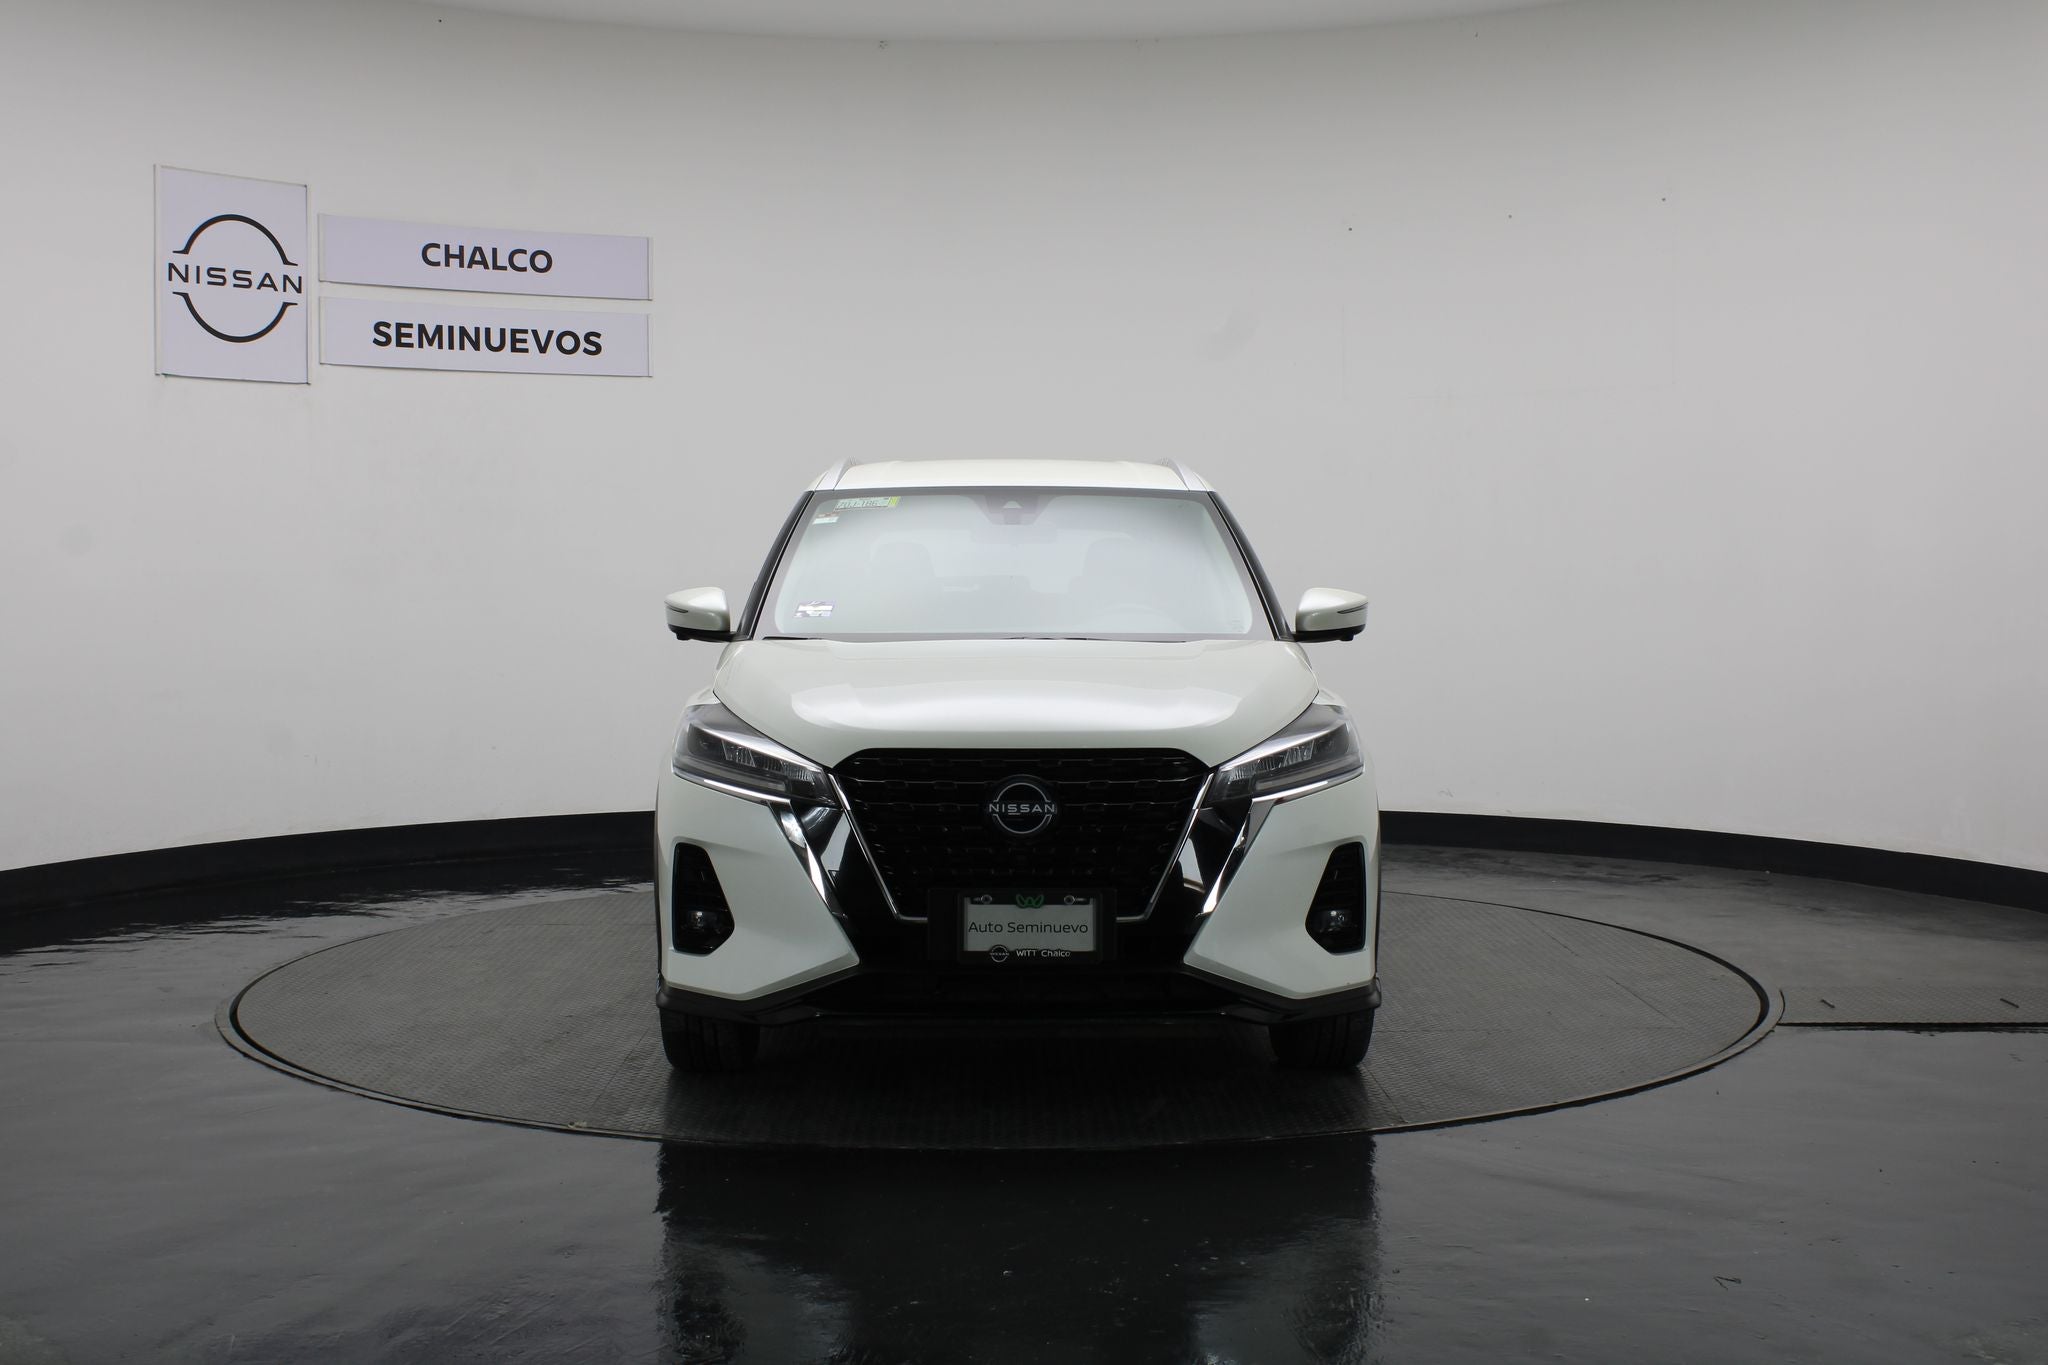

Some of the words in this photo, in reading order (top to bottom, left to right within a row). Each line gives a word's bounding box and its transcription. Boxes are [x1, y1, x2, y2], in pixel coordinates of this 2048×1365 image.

[421, 243, 553, 273] CHALCO
[168, 262, 302, 294] NISSAN
[372, 320, 602, 356] SEMINUEVOS
[989, 803, 1055, 813] NISSAN
[968, 921, 1003, 933] Auto
[1007, 921, 1088, 933] Seminuevo
[1041, 949, 1070, 957] Chalco
